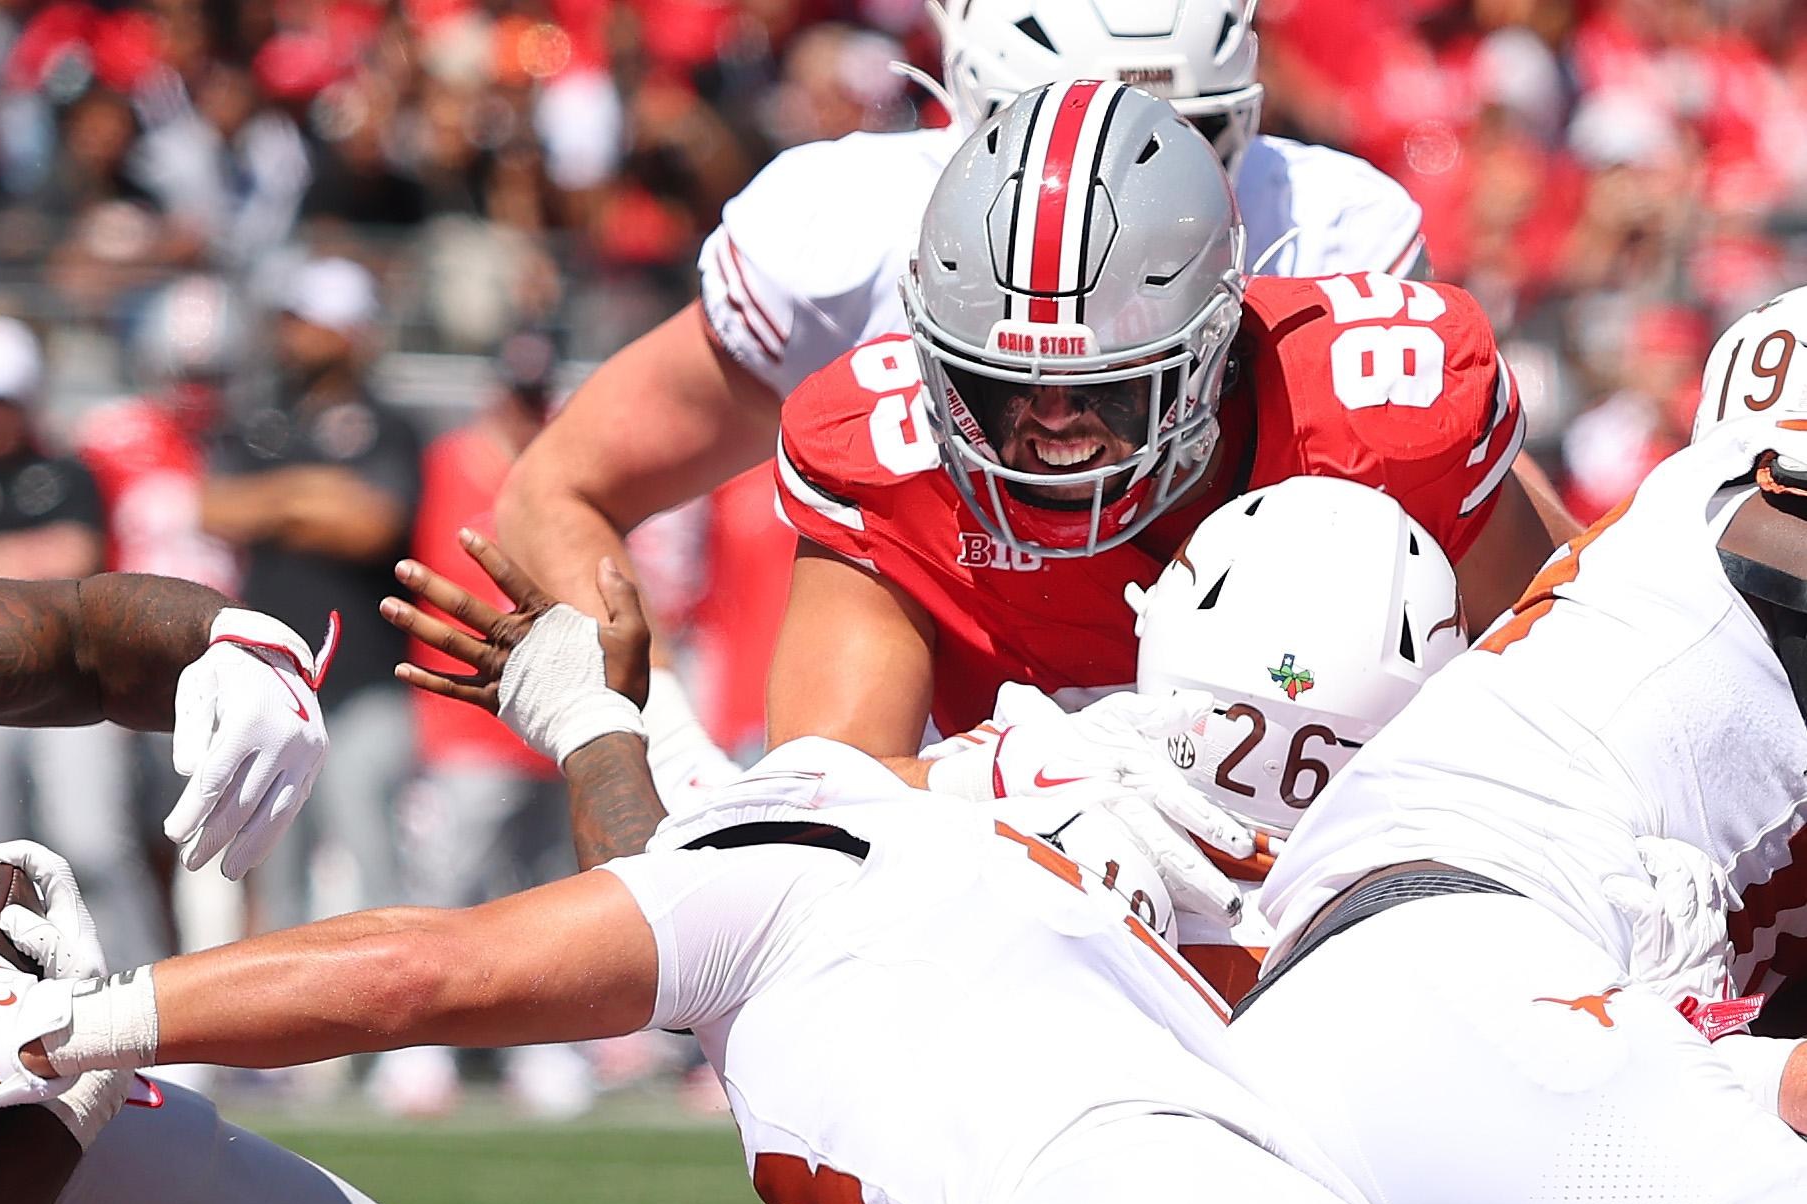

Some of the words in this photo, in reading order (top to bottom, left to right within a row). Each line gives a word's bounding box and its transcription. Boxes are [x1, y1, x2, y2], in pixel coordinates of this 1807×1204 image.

[997, 331, 1034, 353] OHIO
[1040, 335, 1086, 356] STATE
[1315, 271, 1447, 411] 85
[1717, 329, 1796, 423] 19
[1168, 735, 1195, 769] SEC
[1215, 703, 1337, 809] 26
